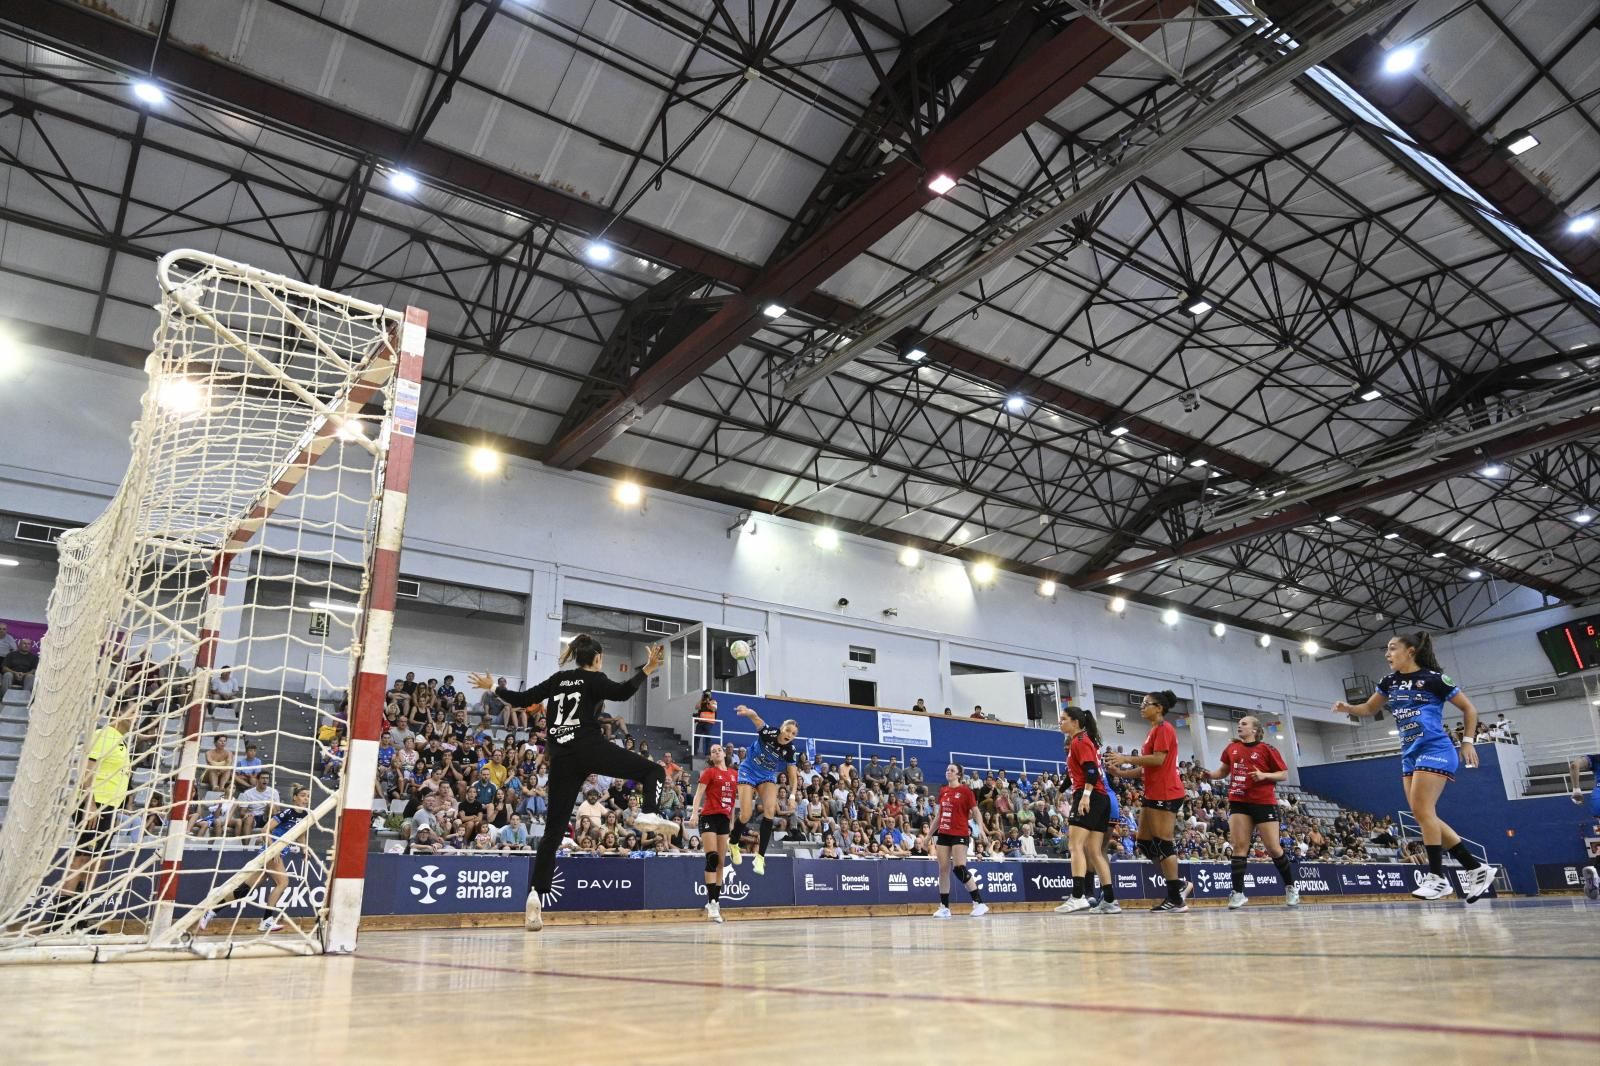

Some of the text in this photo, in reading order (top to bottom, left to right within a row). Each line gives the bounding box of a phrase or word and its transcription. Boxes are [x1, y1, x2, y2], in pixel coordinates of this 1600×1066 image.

[1399, 680, 1412, 690] 24
[553, 691, 582, 725] 12
[457, 869, 509, 884] super
[841, 874, 869, 882] Donostia
[888, 872, 907, 882] AVIA
[987, 871, 1013, 883] super
[577, 879, 632, 889] DAVID
[988, 882, 1017, 892] amara
[1294, 880, 1330, 891] GIPUZKOA
[456, 885, 512, 898] amara
